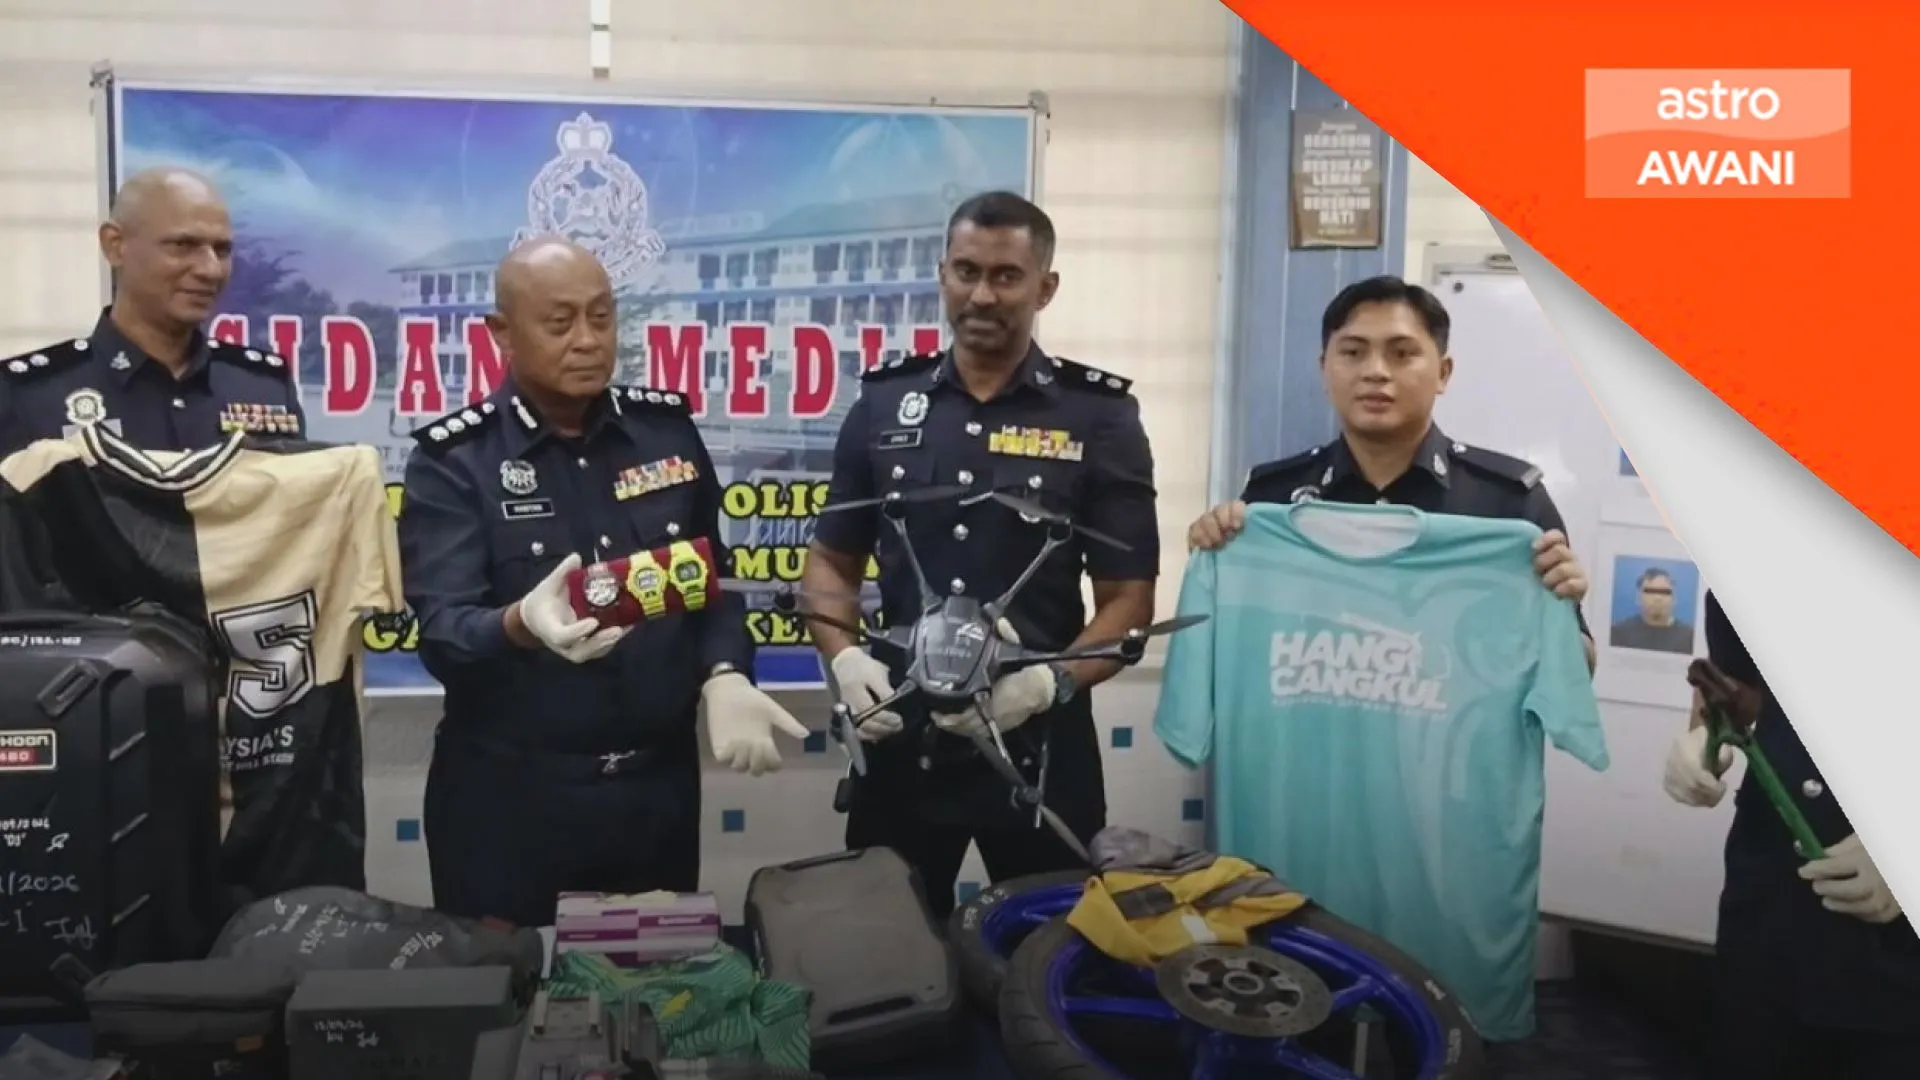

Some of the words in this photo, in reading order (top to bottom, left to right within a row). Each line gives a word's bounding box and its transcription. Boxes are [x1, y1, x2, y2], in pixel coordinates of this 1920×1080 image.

[721, 478, 832, 519] OLIS
[210, 591, 318, 719] 5
[1270, 629, 1415, 675] HANG
[1270, 667, 1447, 710] CANGKUL
